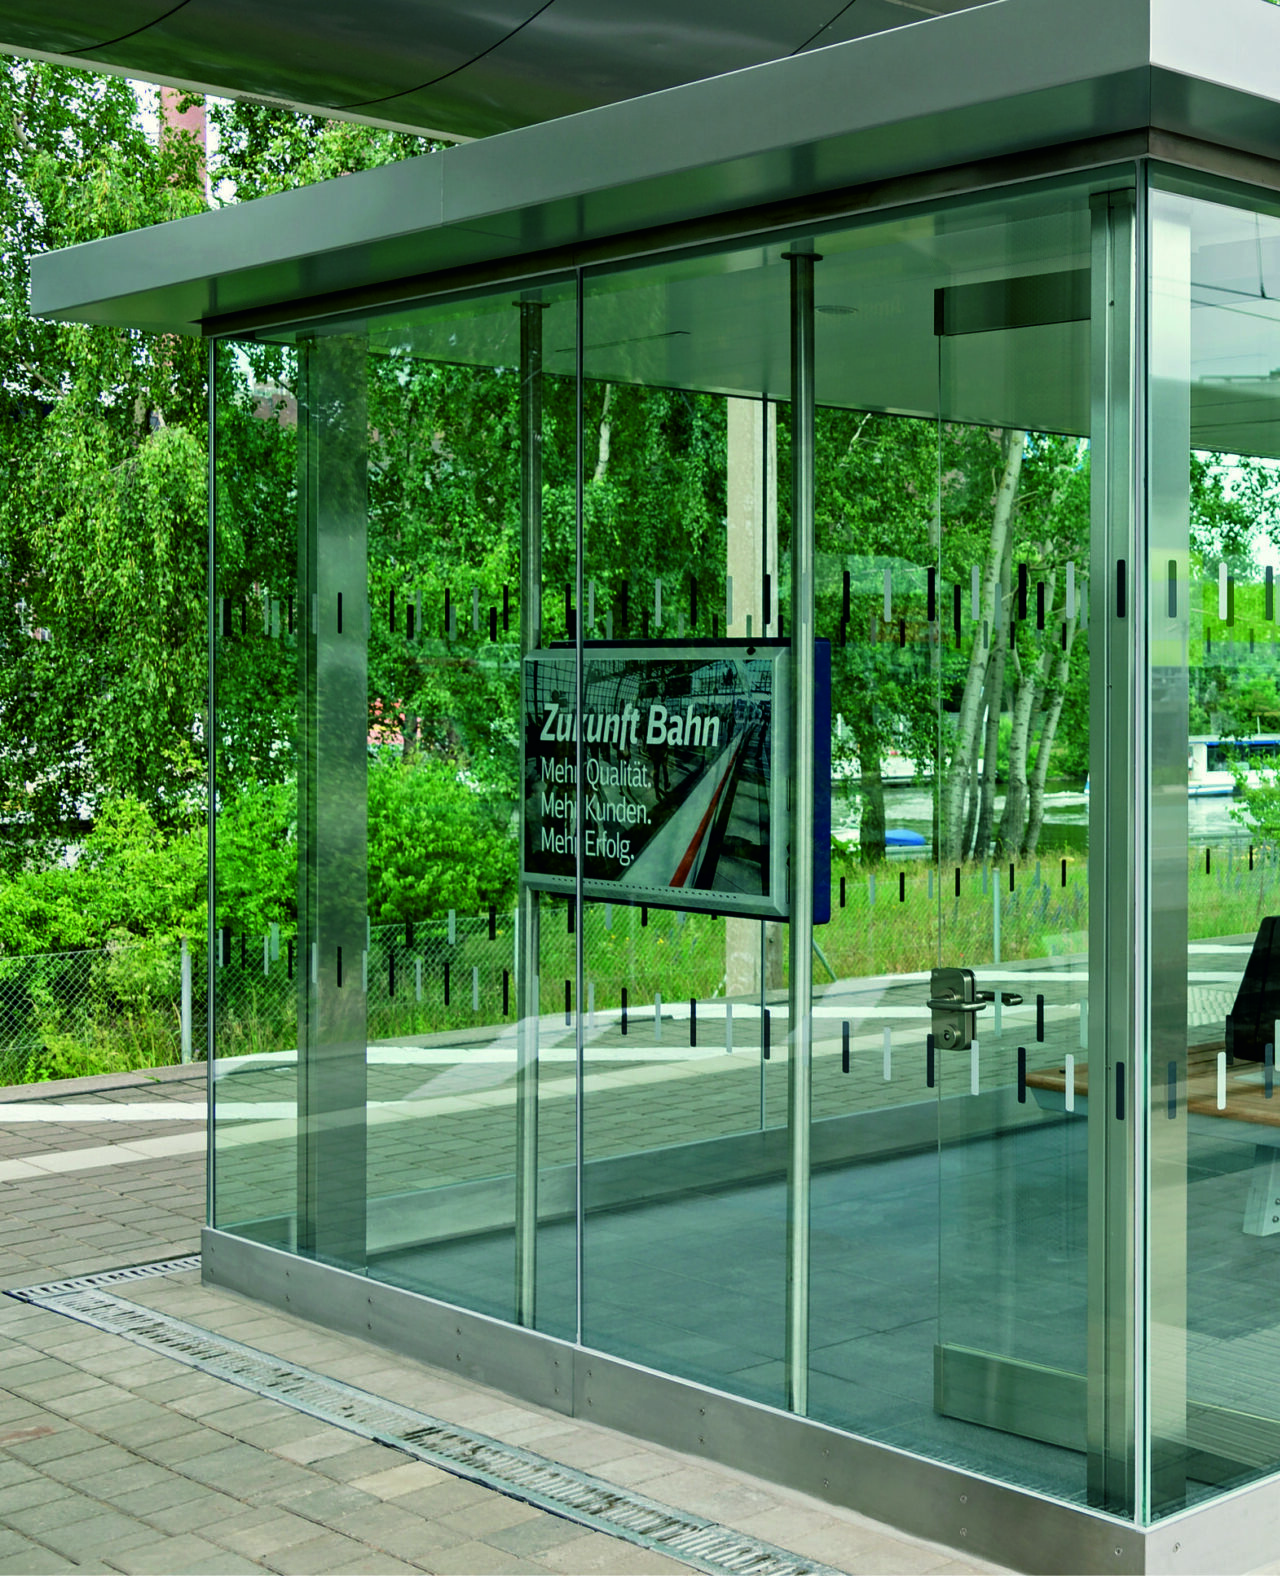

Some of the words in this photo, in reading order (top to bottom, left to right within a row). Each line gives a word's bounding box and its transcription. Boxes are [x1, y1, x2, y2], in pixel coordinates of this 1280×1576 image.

[646, 704, 720, 746] Bahn
[586, 758, 652, 792] Qualität.
[585, 793, 652, 825] Kunden.
[585, 830, 635, 866] Erfolg.
